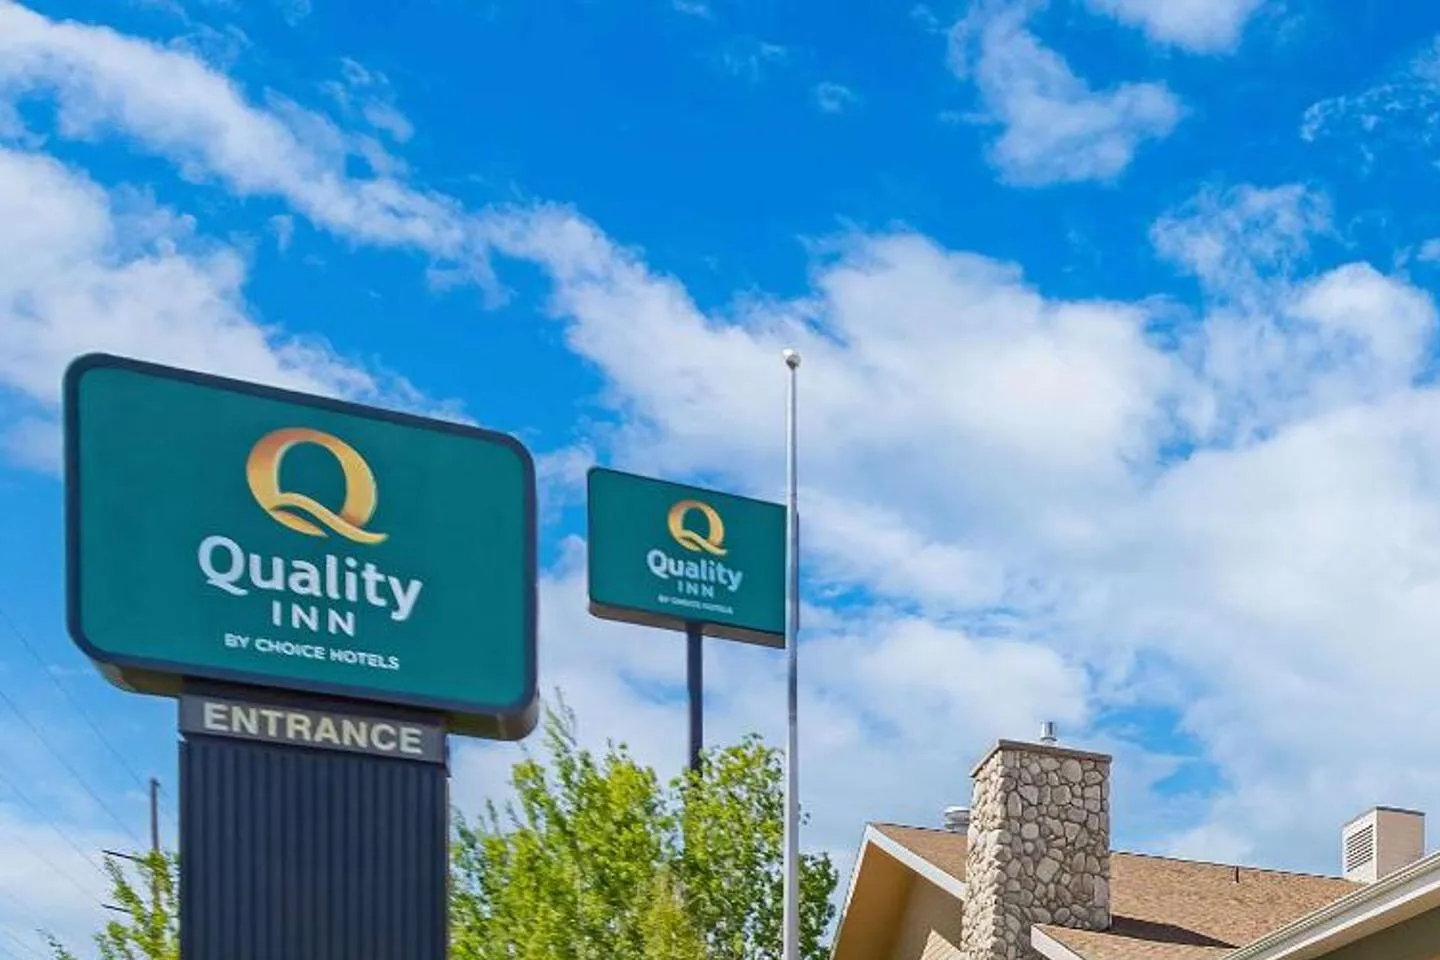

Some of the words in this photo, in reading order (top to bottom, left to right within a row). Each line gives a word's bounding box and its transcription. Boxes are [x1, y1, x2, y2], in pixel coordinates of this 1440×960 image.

[198, 534, 424, 622] Quality
[646, 549, 743, 592] Quality
[677, 580, 715, 599] INN
[271, 601, 355, 637] INN
[224, 633, 250, 649] BY
[255, 638, 326, 661] CHOICE
[330, 649, 400, 670] HOTELS
[203, 702, 424, 755] ENTRANCE
